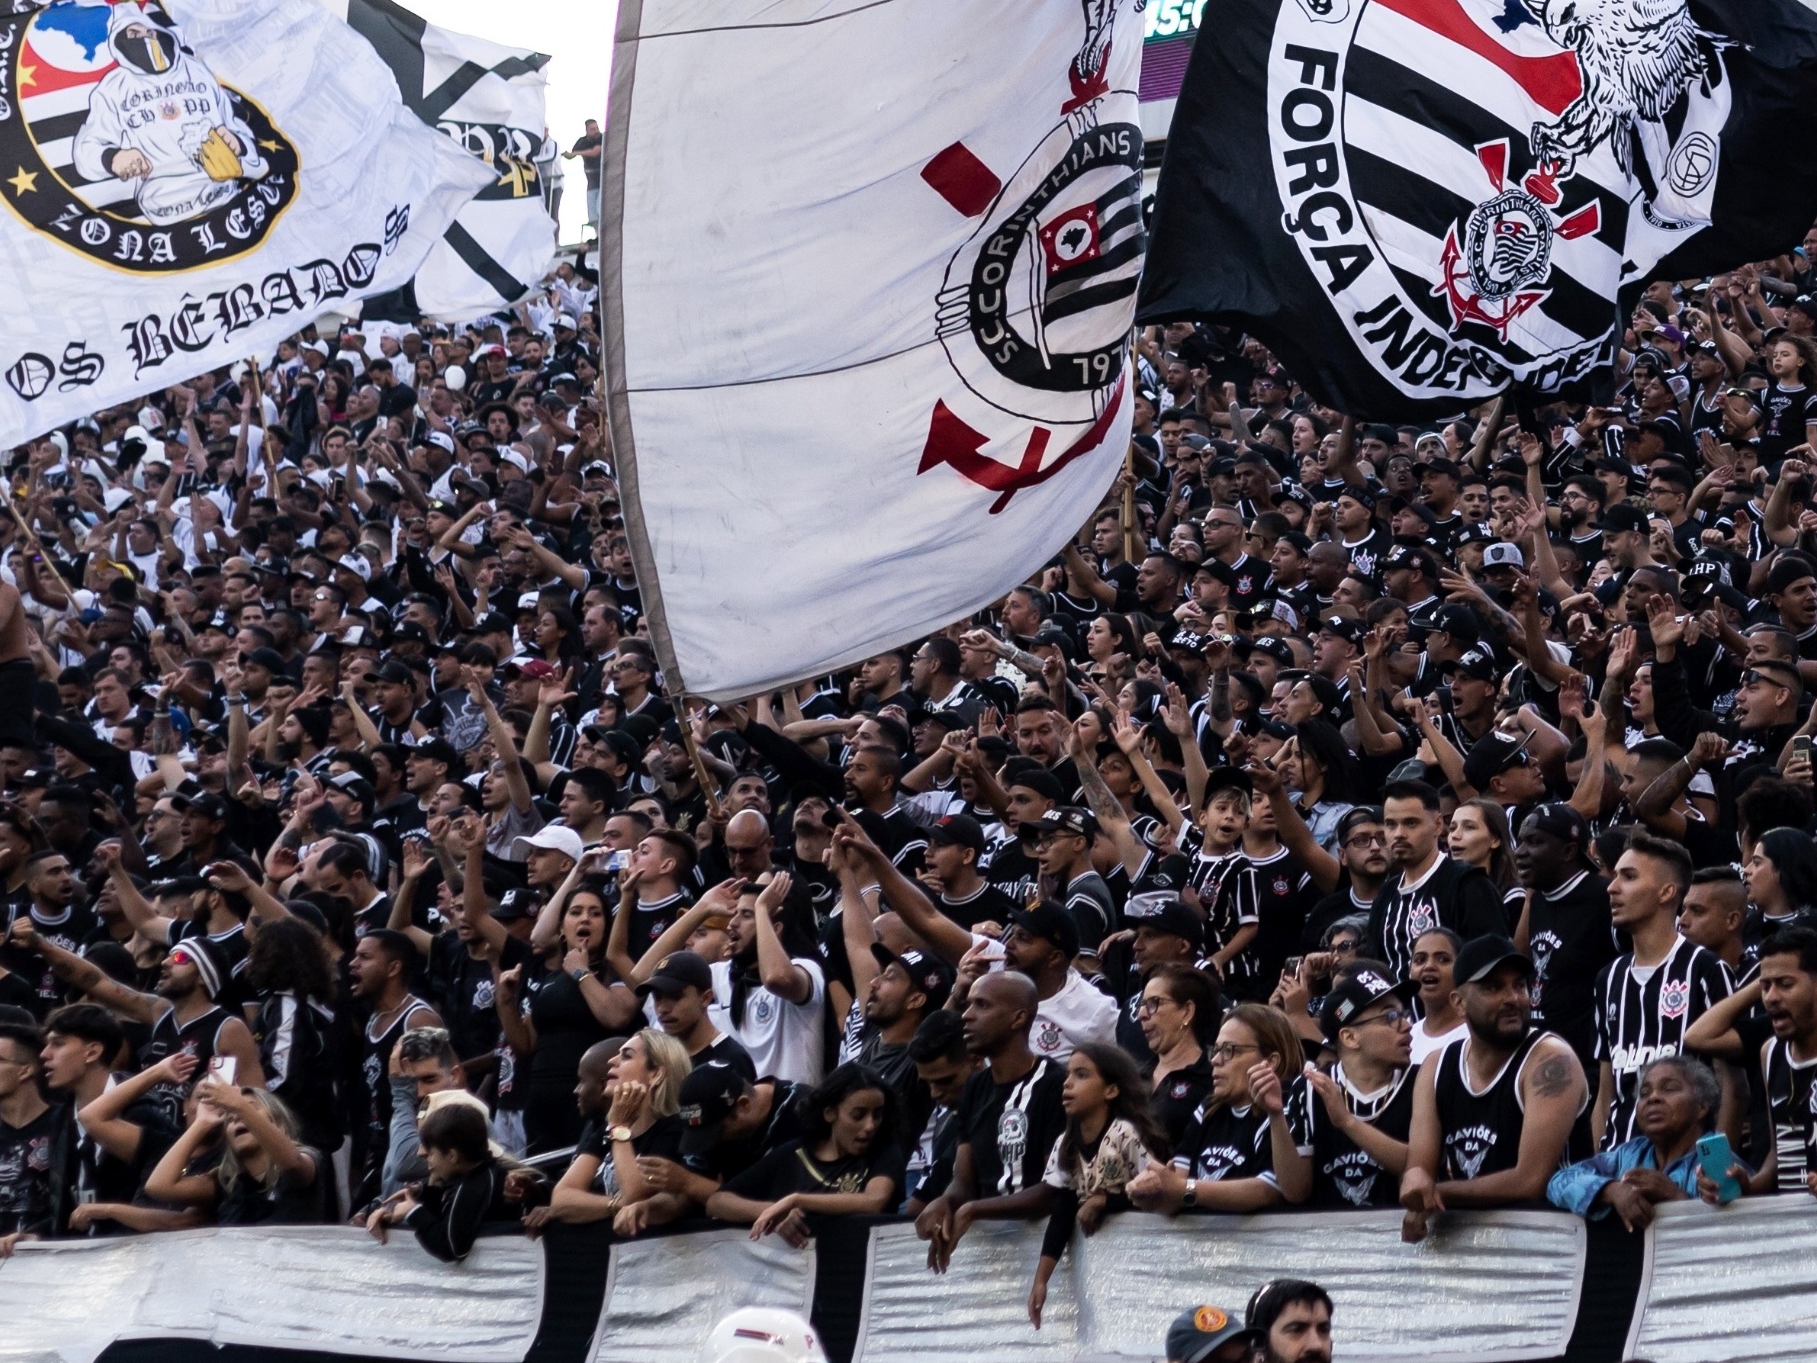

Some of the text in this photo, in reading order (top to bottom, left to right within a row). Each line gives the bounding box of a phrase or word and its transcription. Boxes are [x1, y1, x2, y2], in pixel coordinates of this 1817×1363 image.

[1280, 44, 1370, 295] FORÇA
[5, 203, 411, 402] OS BÊBADOS
[46, 931, 75, 953] VIÕES
[1445, 1123, 1499, 1147] GAVIÕES
[1464, 1141, 1480, 1152] DA
[1200, 1144, 1248, 1169] AVIÕES
[1205, 1155, 1221, 1168] DA
[1322, 1149, 1383, 1175] GAVIÕE
[1344, 1167, 1363, 1179] DA
